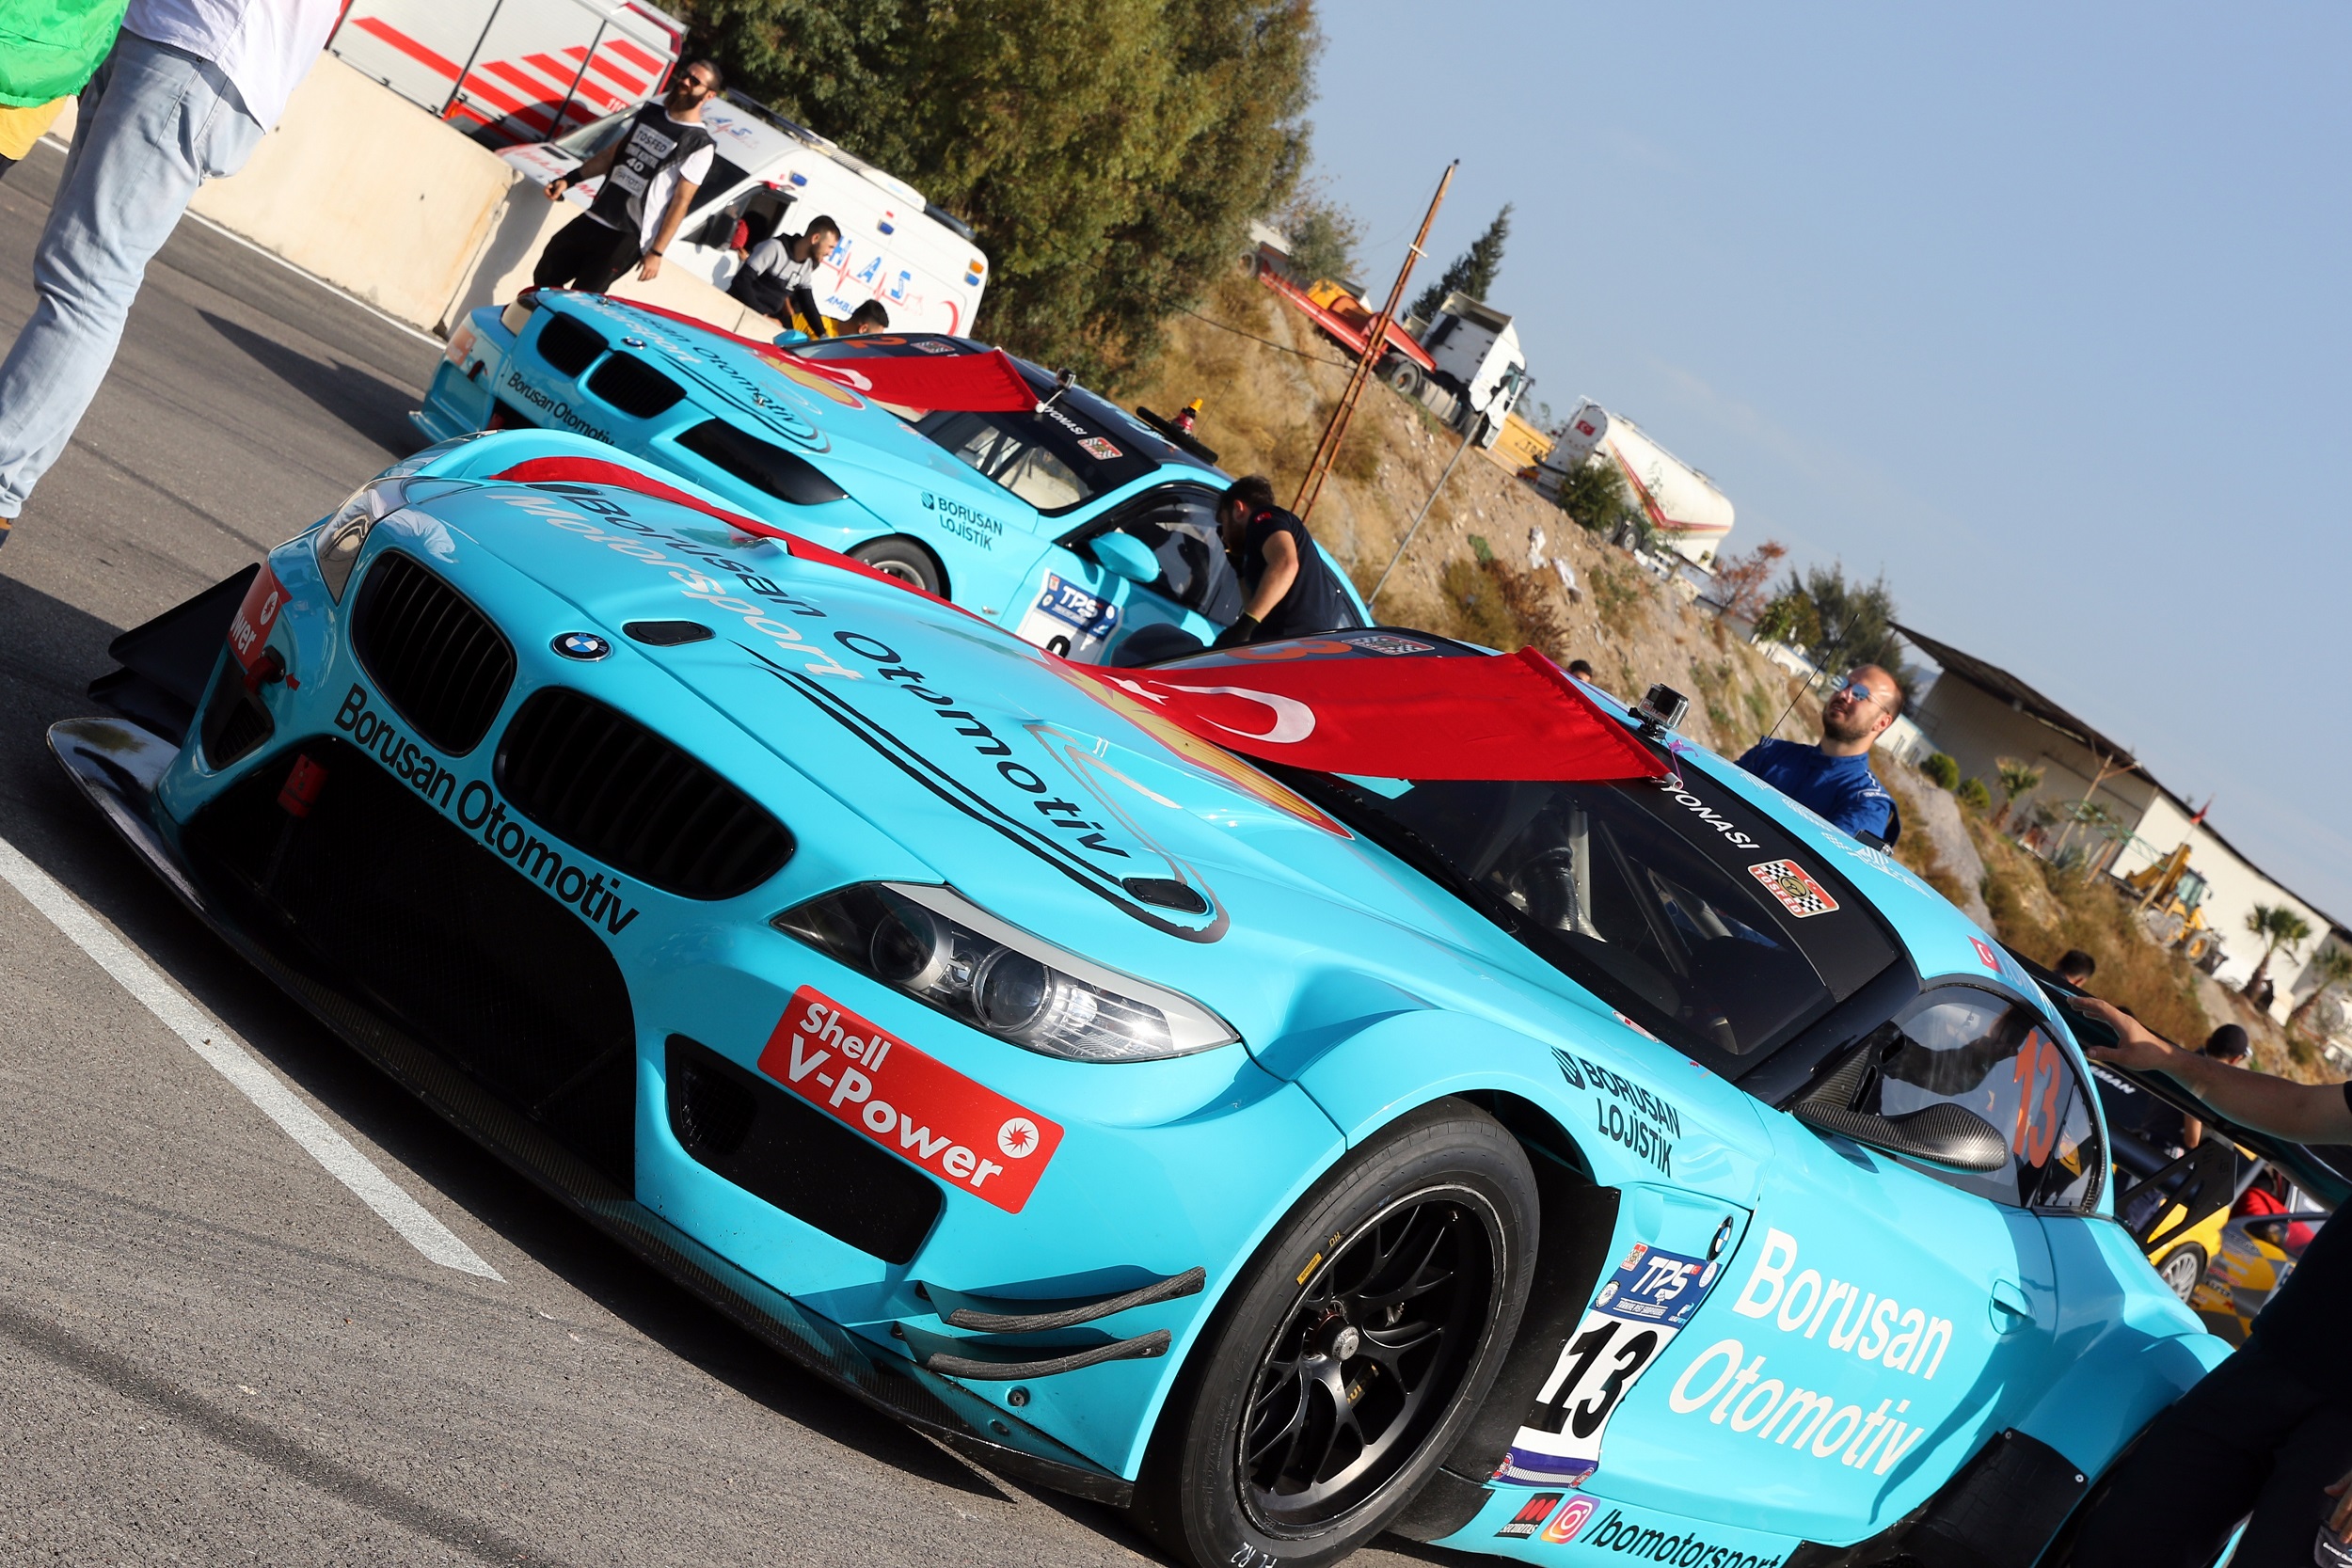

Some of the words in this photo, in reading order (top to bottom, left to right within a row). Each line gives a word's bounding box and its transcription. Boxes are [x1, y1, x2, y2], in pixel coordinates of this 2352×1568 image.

[626, 157, 644, 172] 40
[636, 131, 668, 153] TOSFED
[506, 372, 566, 414] Borusan
[552, 402, 616, 447] Otomotiv
[938, 497, 1003, 536] BORUSAN
[939, 514, 993, 551] LOJİSTİK
[486, 494, 864, 681] Motorsport
[1059, 585, 1099, 619] TPS
[559, 494, 827, 618] Borusan
[834, 630, 1132, 860] Otomotiv
[334, 682, 456, 810] Borusan
[456, 780, 640, 936] Otomotiv
[1754, 868, 1803, 913] TOSFED
[799, 1002, 893, 1072] Shell
[787, 1033, 1004, 1188] V-Power
[1576, 1055, 1682, 1141] BORUSAN
[2012, 1029, 2061, 1169] 13
[1596, 1097, 1673, 1180] LOJİSTİK
[1629, 1256, 1695, 1300] TPS
[1732, 1227, 1953, 1381] Borusan
[1518, 1321, 1659, 1440] 13
[1669, 1338, 1924, 1476] Otomotiv
[1500, 1524, 1539, 1535] SECURITAS
